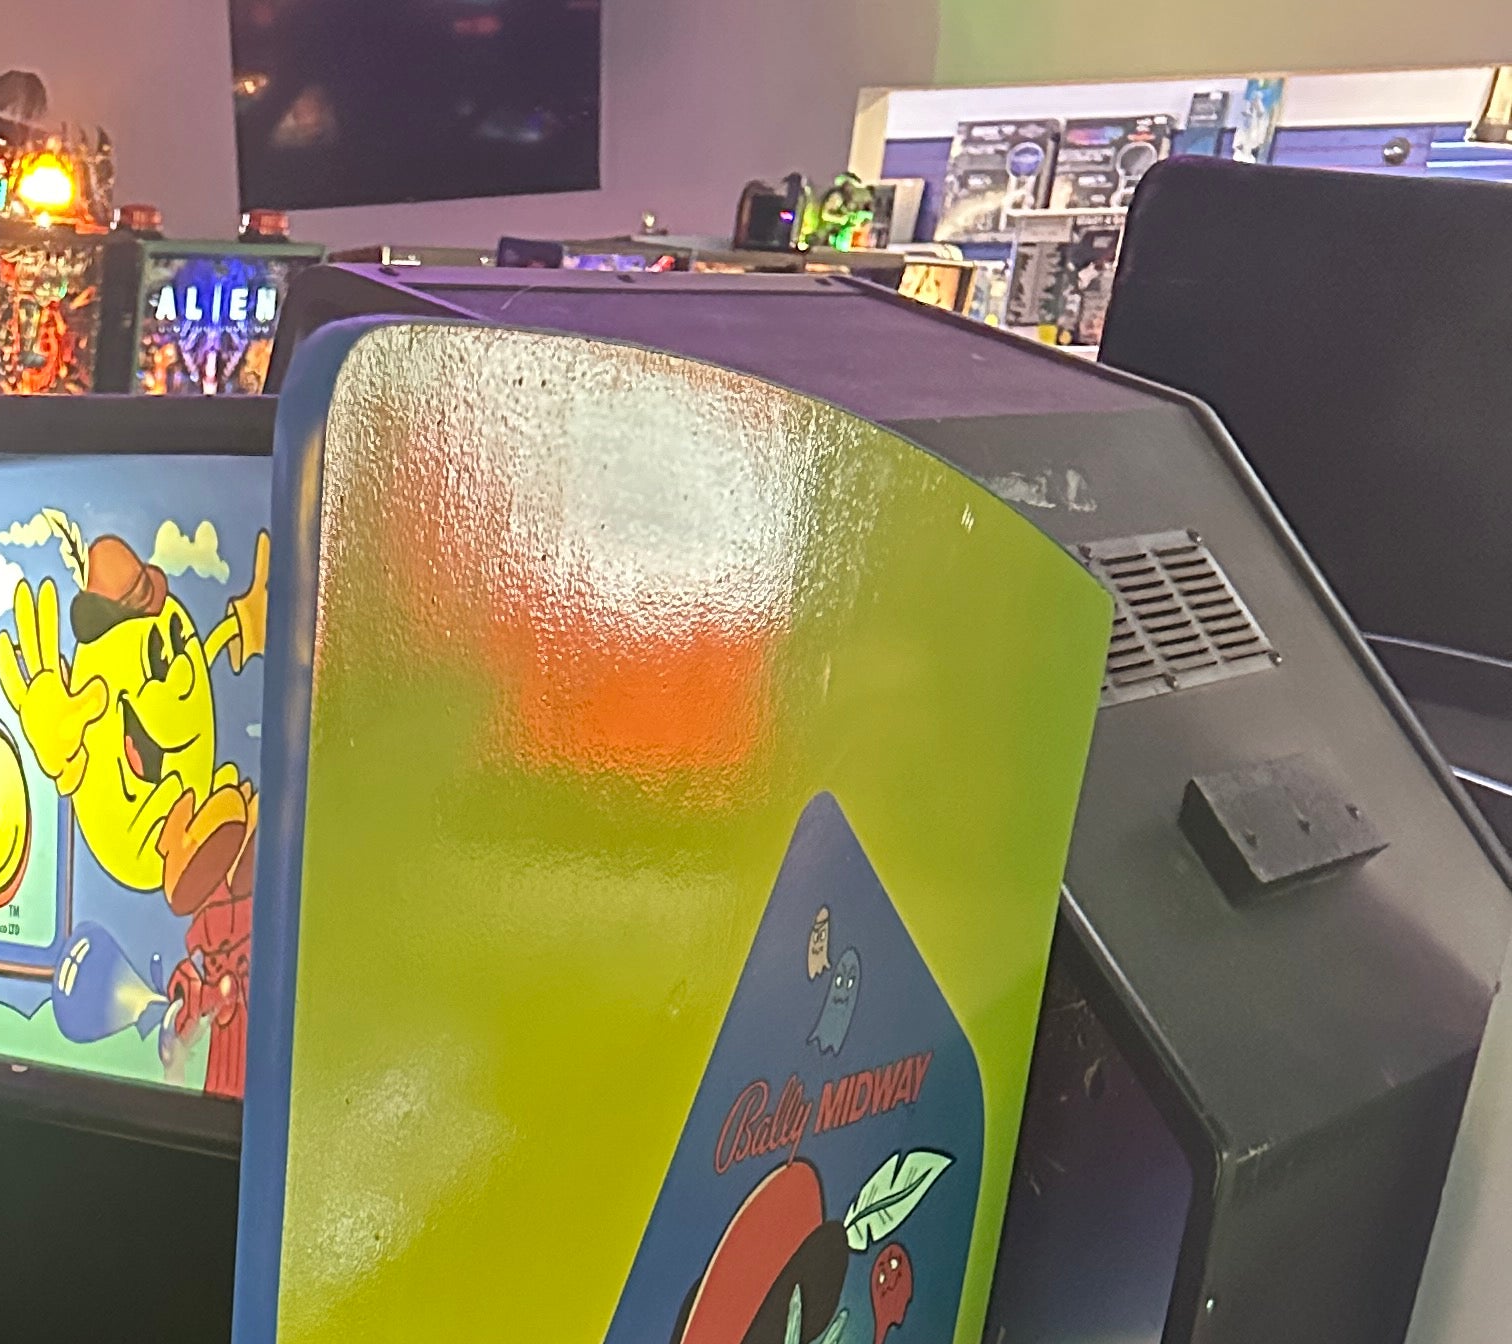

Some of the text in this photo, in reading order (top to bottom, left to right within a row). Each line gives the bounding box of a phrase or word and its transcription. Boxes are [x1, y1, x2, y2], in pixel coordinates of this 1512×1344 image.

[155, 282, 277, 324] ALIEN
[8, 904, 20, 918] TM
[714, 1051, 934, 1175] Bally MIDWAY
